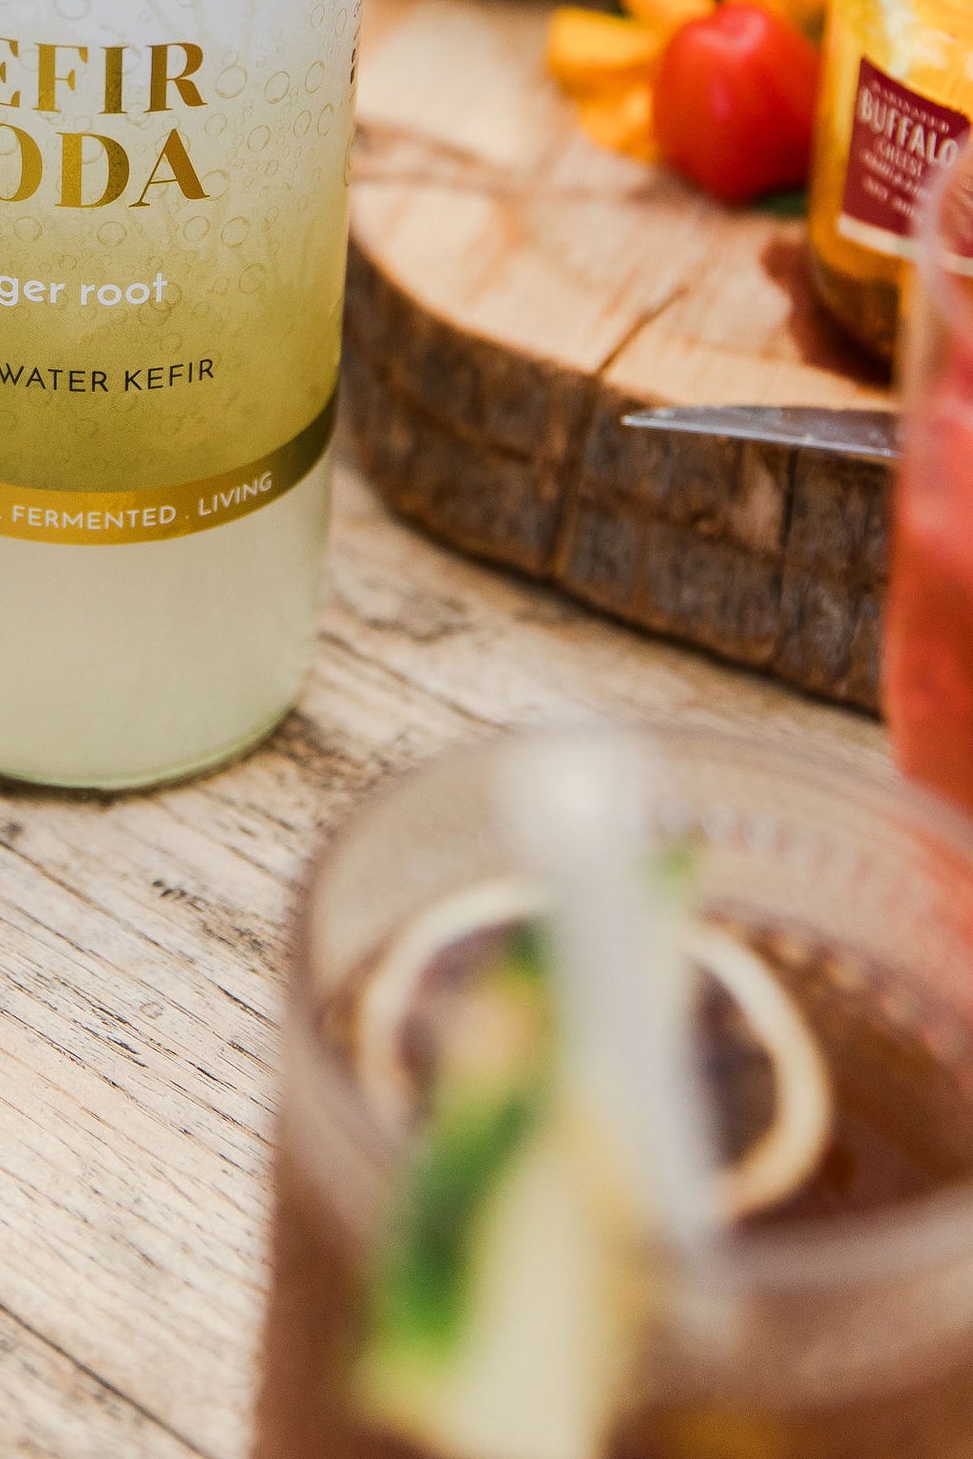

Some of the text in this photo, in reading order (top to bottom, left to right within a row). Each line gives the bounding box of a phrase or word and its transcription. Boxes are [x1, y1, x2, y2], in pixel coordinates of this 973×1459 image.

[857, 86, 959, 166] BUFFALO
[79, 272, 168, 306] root
[124, 358, 215, 393] KEFIR
[12, 505, 177, 531] FERMENTED
[198, 472, 273, 517] LIVING
